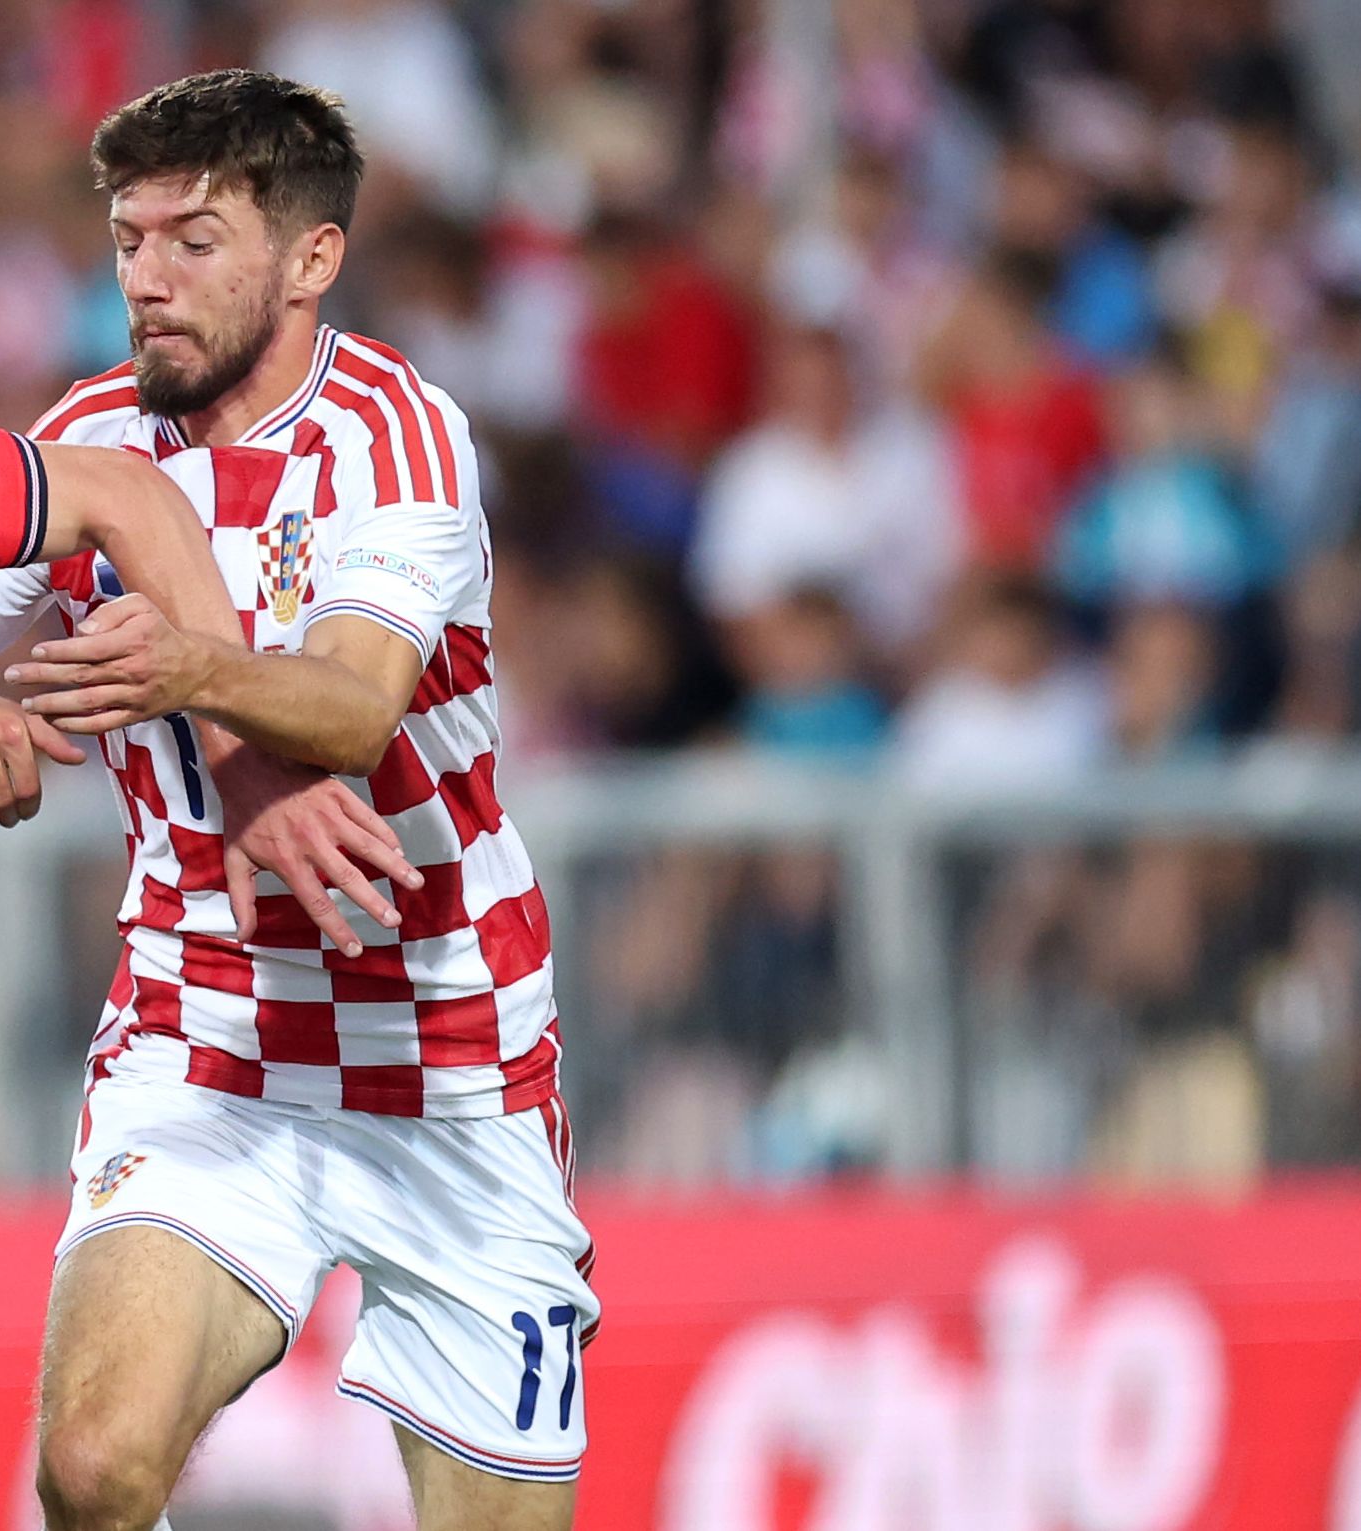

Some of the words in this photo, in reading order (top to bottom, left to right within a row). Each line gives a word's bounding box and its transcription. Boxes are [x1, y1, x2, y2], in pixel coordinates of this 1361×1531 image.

[282, 520, 298, 578] HNS
[336, 554, 440, 594] FOUNDATION
[511, 1304, 577, 1430] 17
